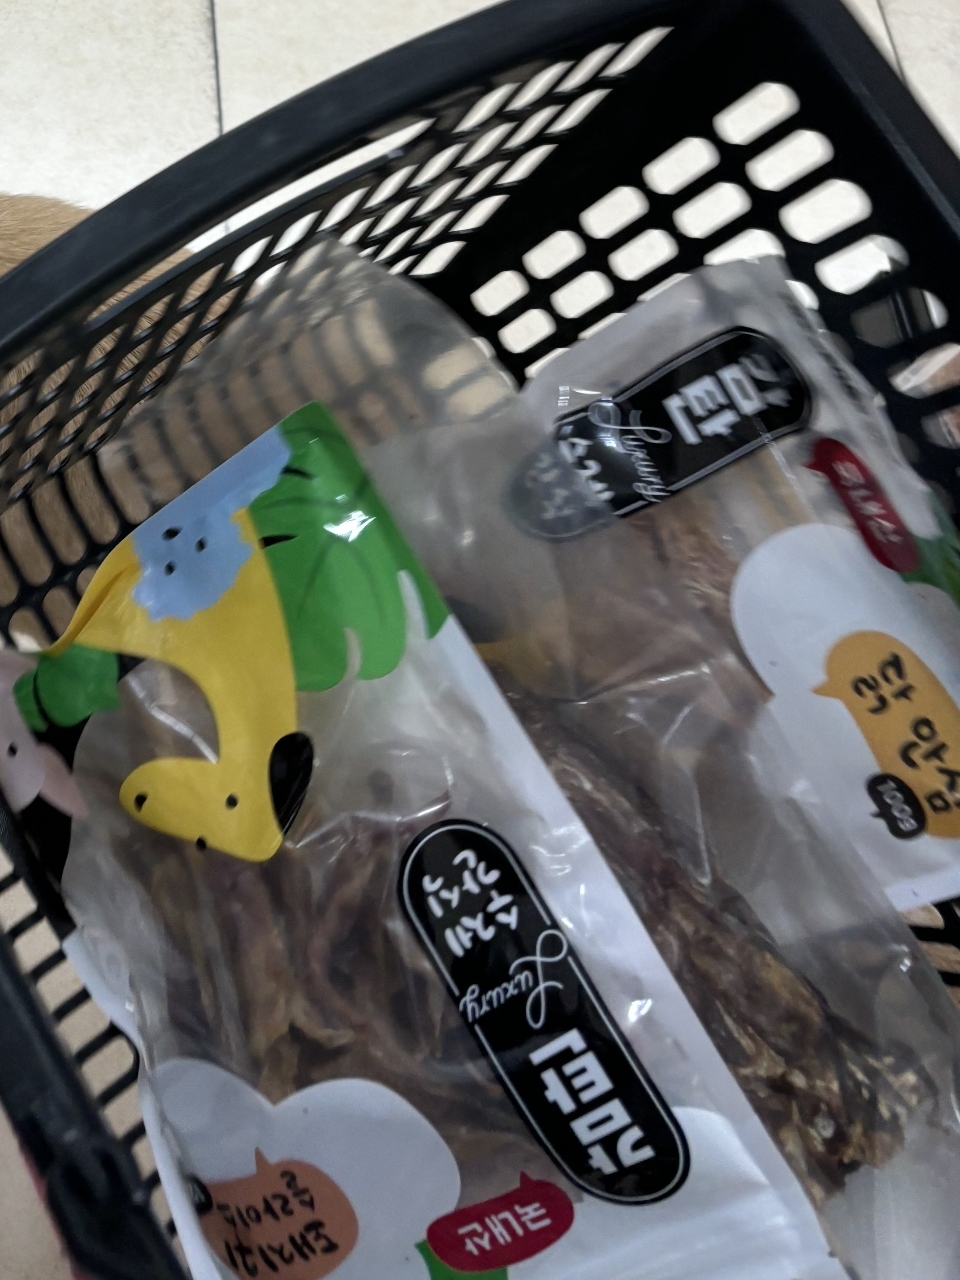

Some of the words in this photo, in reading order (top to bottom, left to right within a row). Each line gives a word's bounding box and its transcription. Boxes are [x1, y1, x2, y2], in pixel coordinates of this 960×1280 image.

[662, 354, 792, 445] 감탄
[588, 401, 673, 503] Luxury
[851, 652, 917, 716] 닭
[876, 778, 919, 834] 100g
[422, 850, 501, 918] 간식
[445, 889, 519, 958] 수제
[459, 928, 569, 1030] Luxury
[528, 1027, 656, 1176] 감탄
[457, 1201, 552, 1257] 국내산
